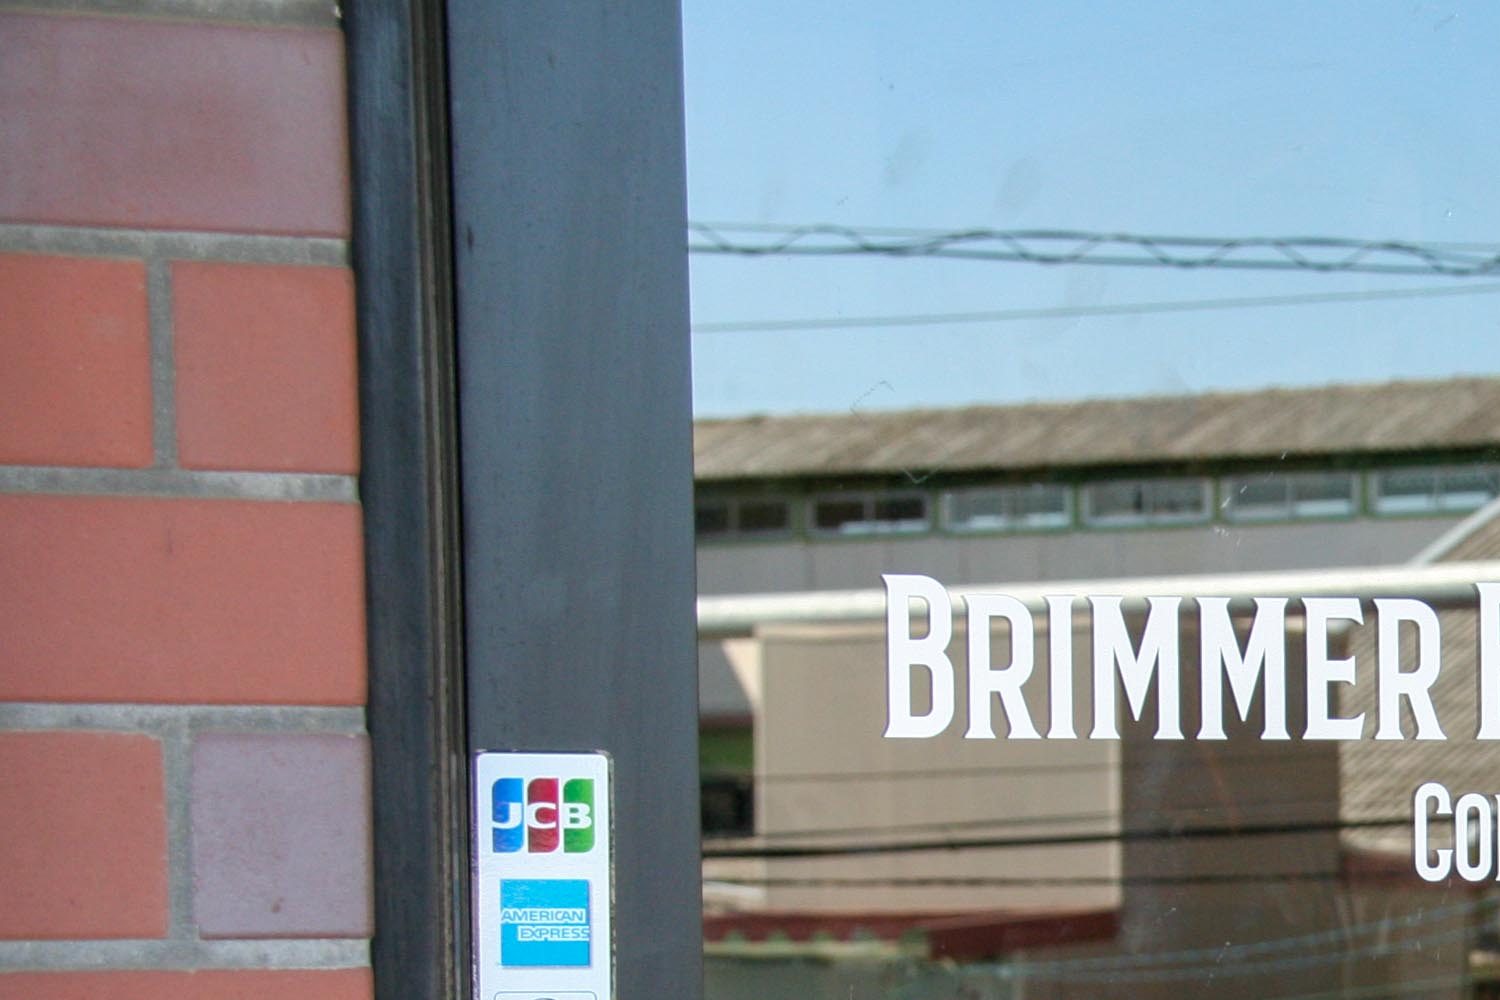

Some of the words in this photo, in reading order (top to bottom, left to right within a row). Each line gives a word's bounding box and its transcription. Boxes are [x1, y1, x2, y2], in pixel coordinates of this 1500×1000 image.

[882, 573, 1448, 741] BRIMMER
[491, 803, 592, 829] JCB
[500, 908, 585, 923] AMERICAN
[518, 927, 590, 940] EXPRESS
